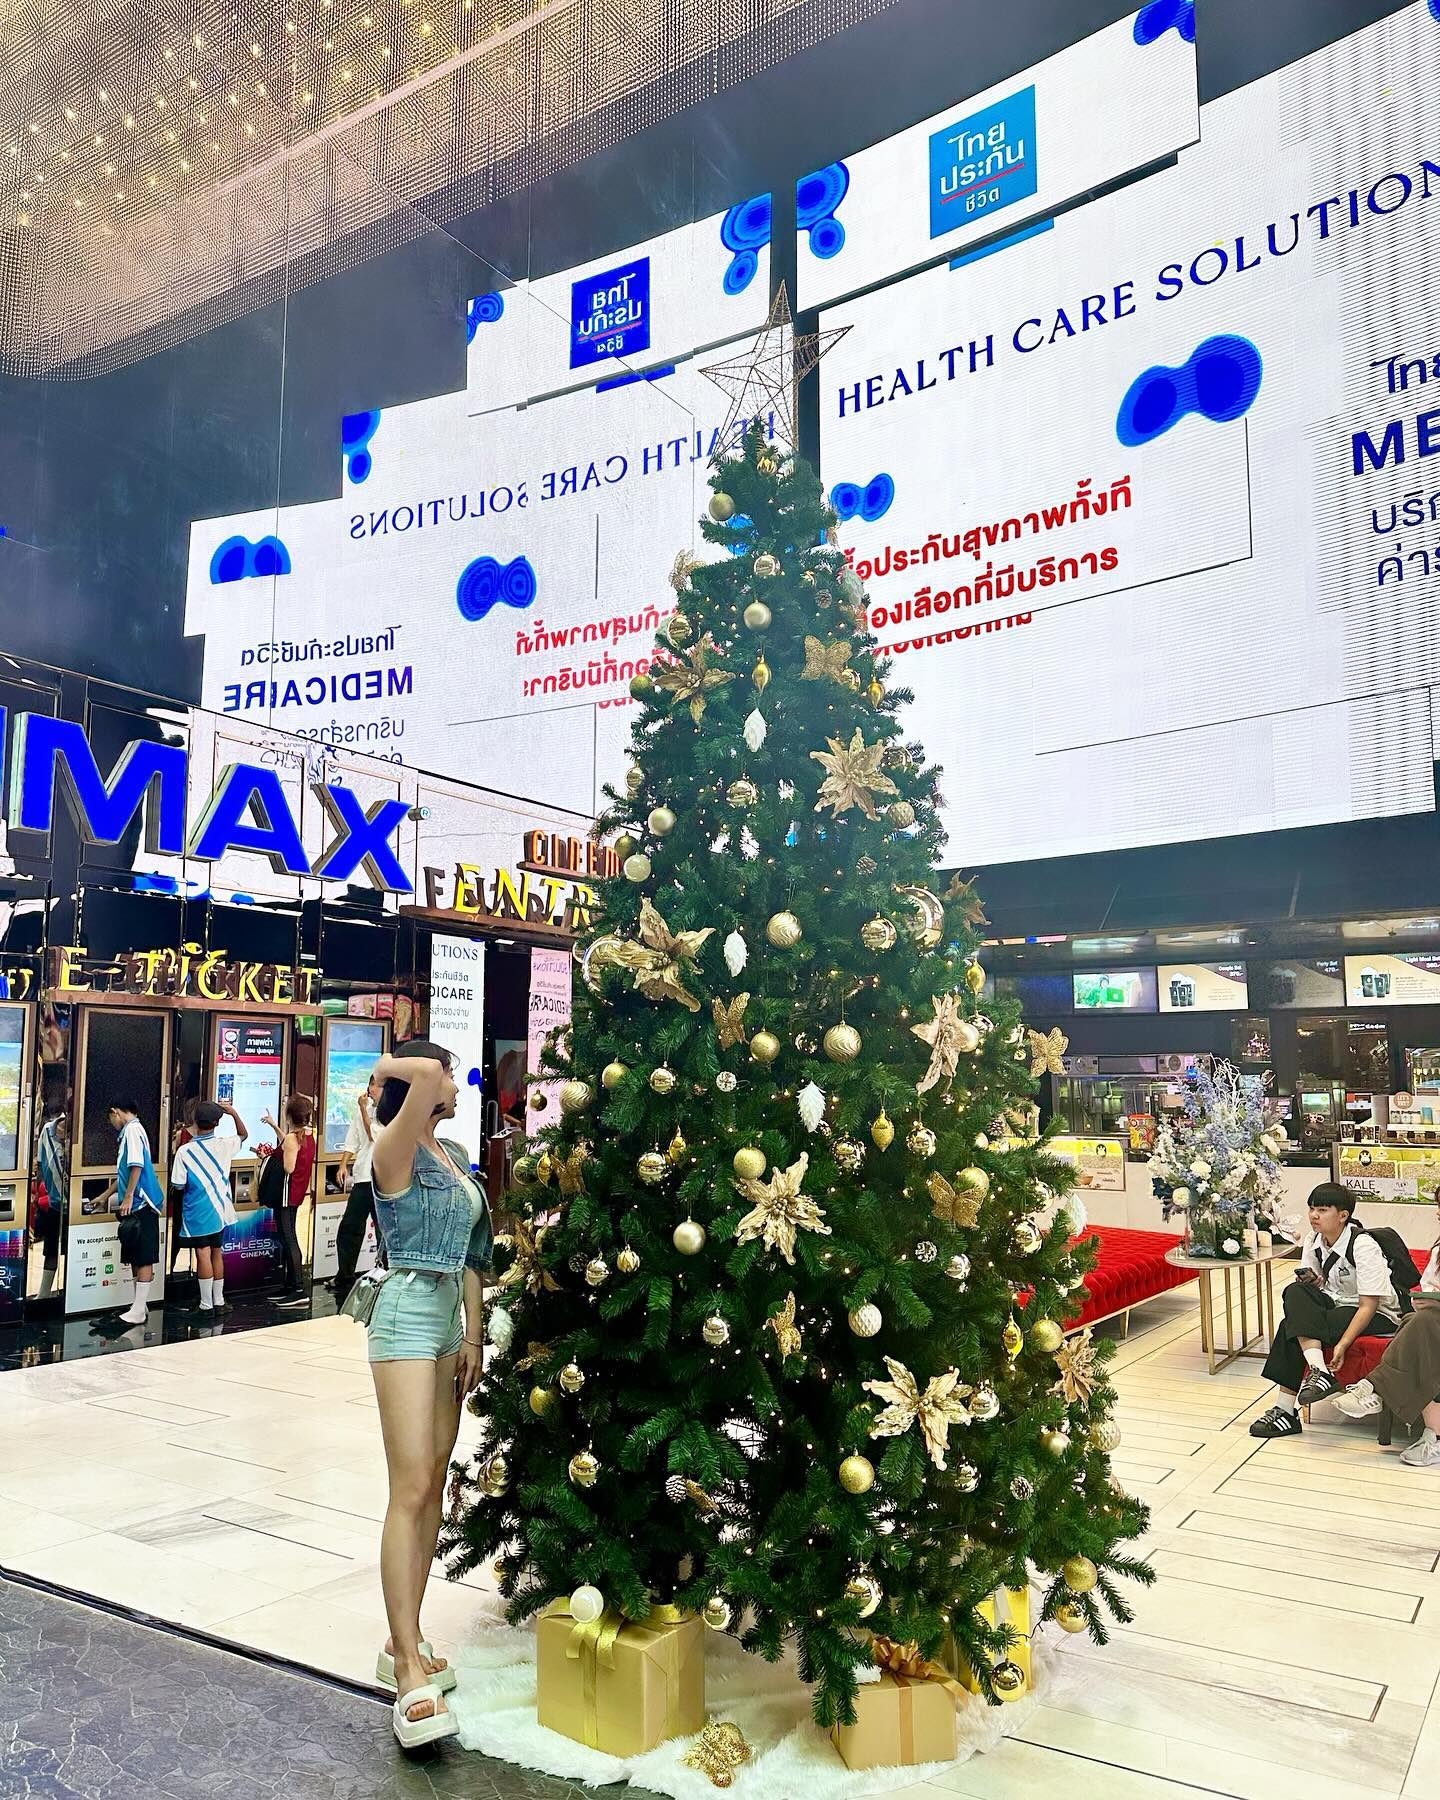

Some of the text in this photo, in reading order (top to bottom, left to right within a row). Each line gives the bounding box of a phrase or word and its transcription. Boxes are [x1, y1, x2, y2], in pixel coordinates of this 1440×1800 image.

[947, 122, 1005, 161] ไทย
[940, 139, 1025, 195] ประกัน
[965, 187, 1001, 213] ชีวิต
[838, 160, 1440, 418] HEALTH CARE SOLUTIO
[1351, 409, 1440, 476] ME
[866, 546, 1119, 629] องเลือกที่มีบริการ
[0, 704, 415, 895] MAX
[525, 829, 621, 877] CINEM
[432, 944, 479, 961] UTIONS
[430, 986, 473, 1001] DICARE
[1346, 1179, 1375, 1190] KALE
[221, 1238, 272, 1252] SHLESS
